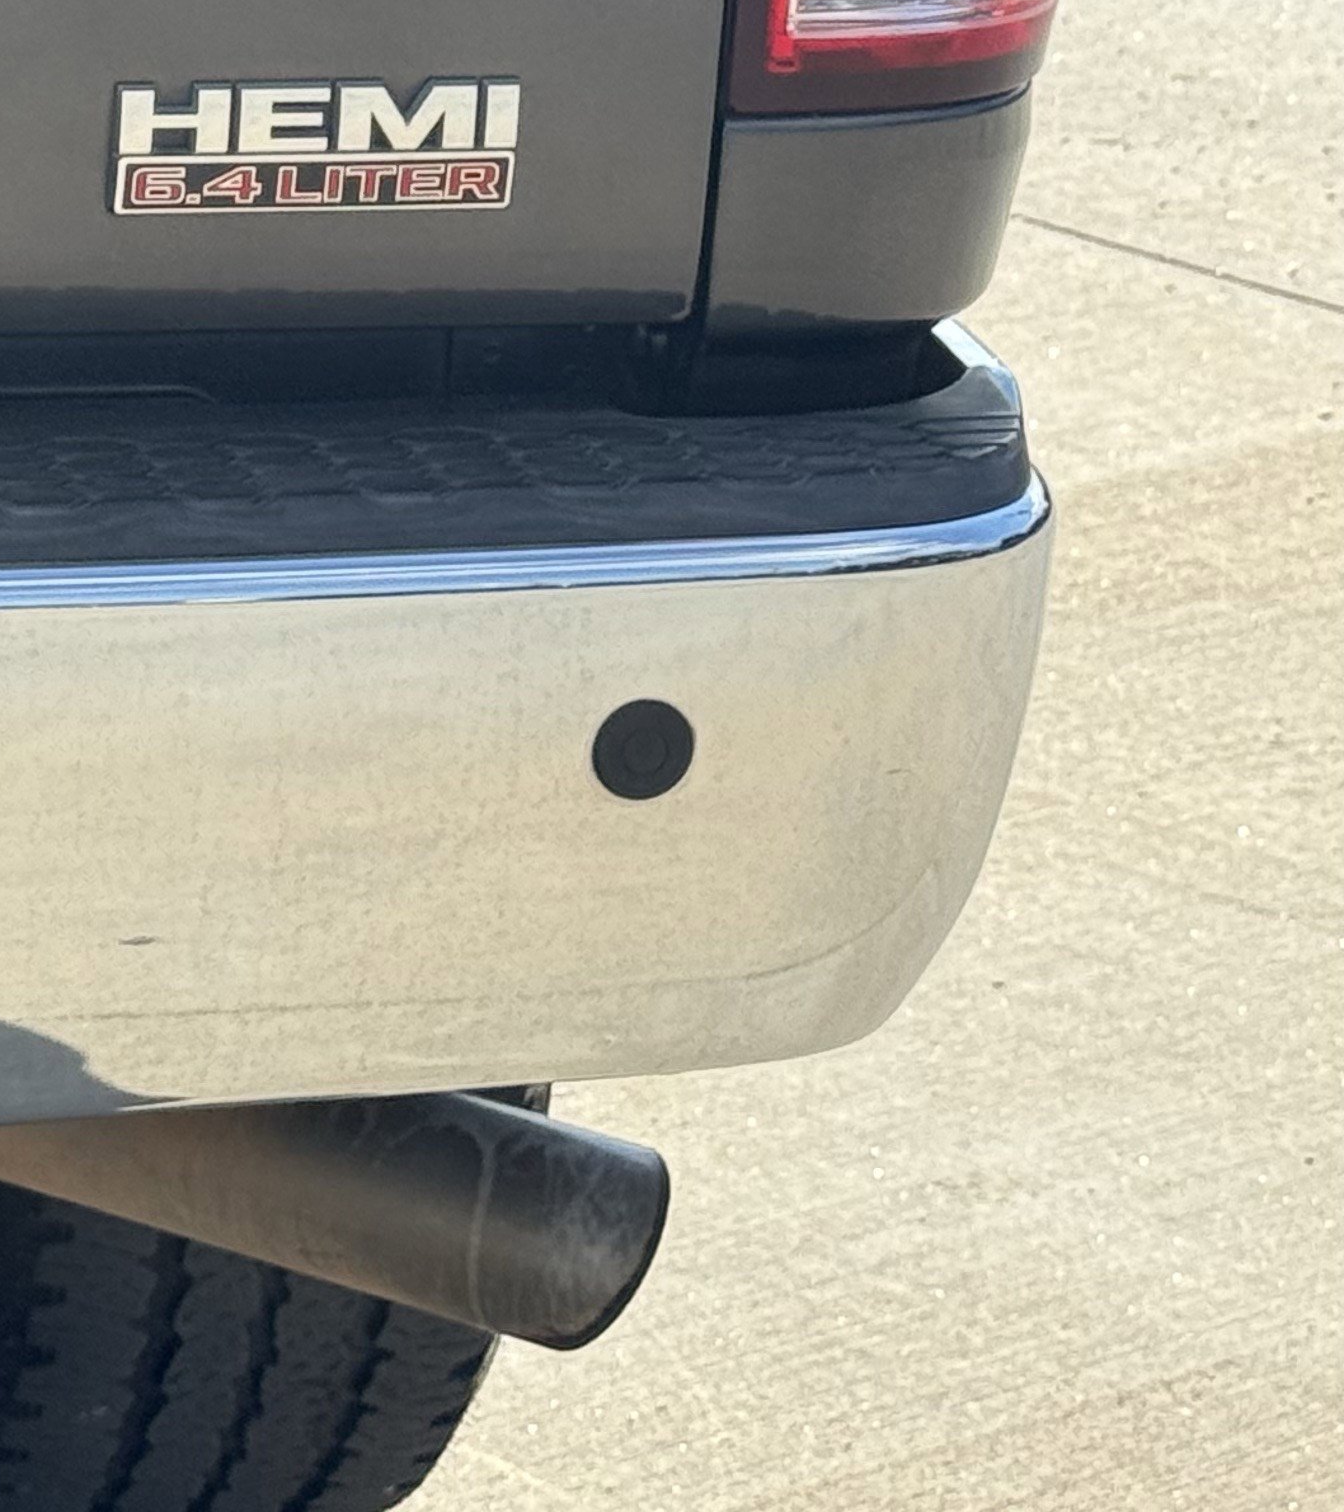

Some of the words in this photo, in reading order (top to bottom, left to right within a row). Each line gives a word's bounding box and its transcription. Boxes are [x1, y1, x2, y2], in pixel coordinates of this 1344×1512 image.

[117, 80, 522, 156] HEMI
[130, 164, 264, 206] 6.4
[274, 161, 503, 205] LITER
